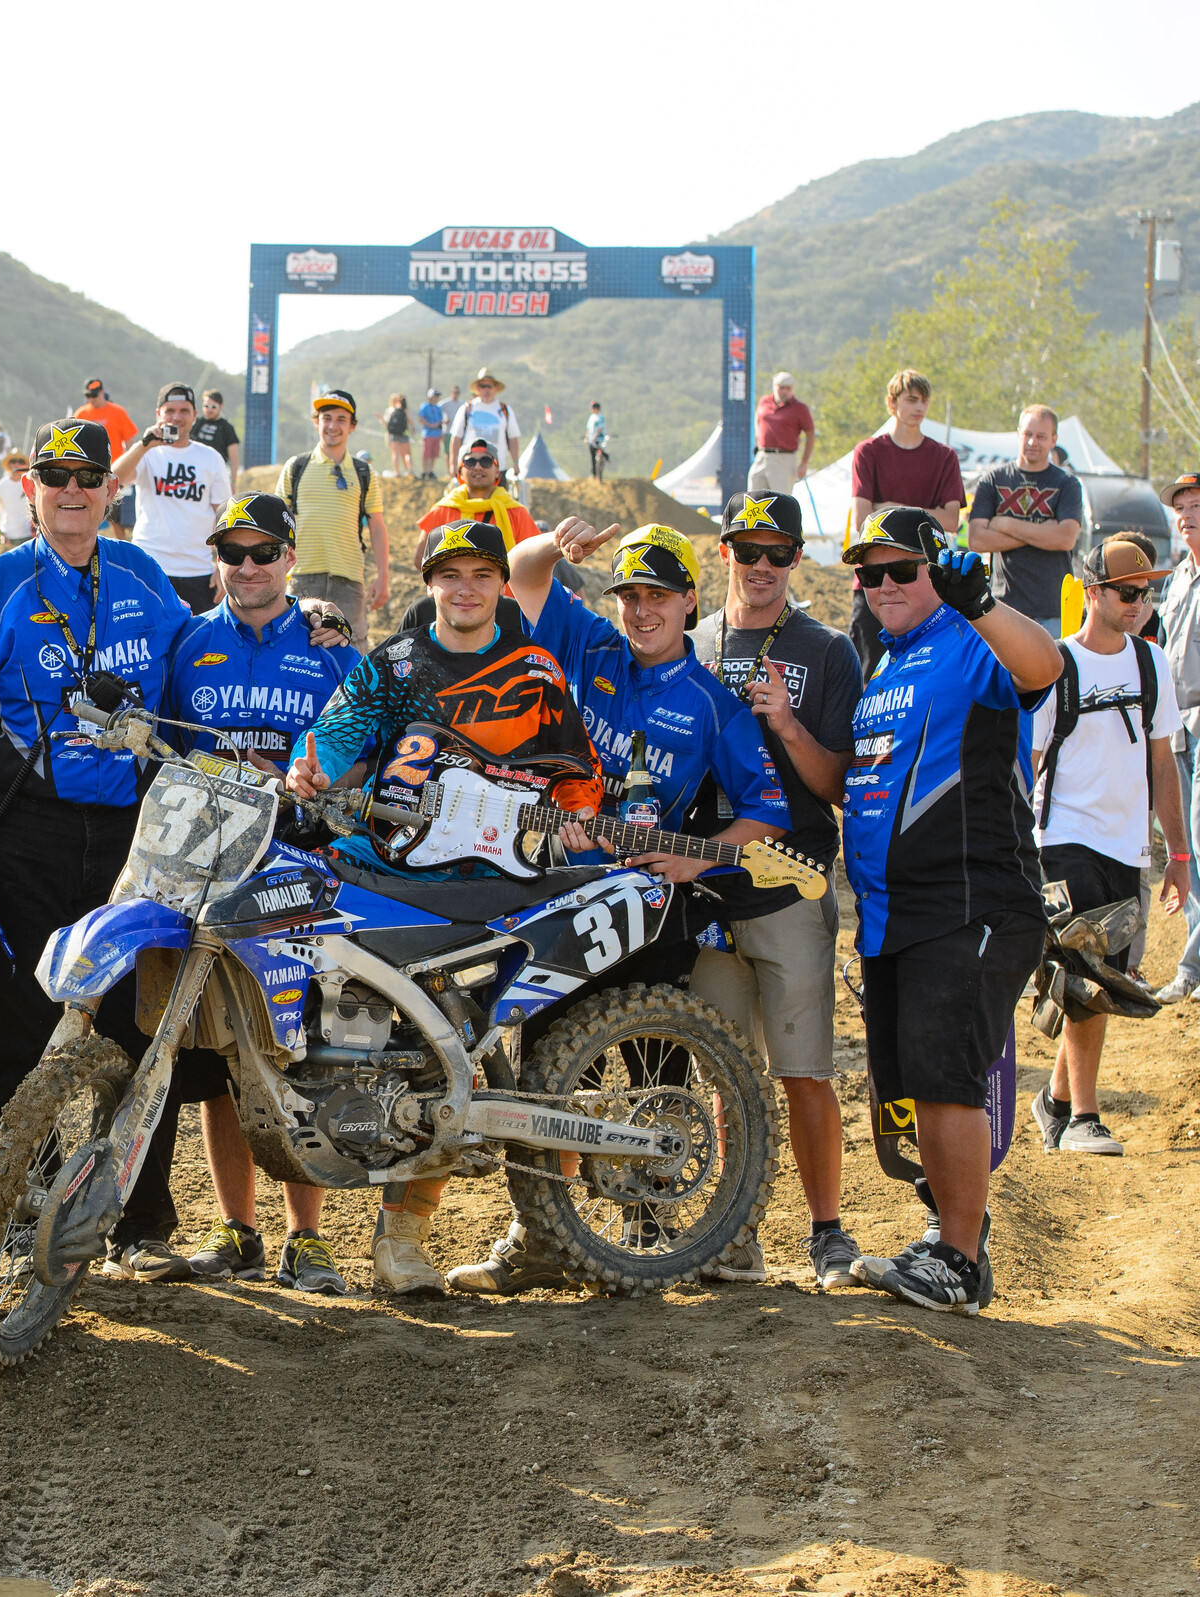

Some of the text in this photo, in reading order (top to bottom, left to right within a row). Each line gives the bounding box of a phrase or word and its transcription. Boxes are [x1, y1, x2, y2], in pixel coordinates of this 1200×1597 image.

[449, 231, 549, 249] LUCAS OIL
[409, 261, 588, 282] MOTOCROSS
[408, 281, 588, 291] CHAMPIONSHIP
[445, 291, 550, 315] FINISH
[167, 462, 196, 480] LAS
[154, 476, 206, 502] VEGAS
[48, 552, 68, 577] YAMAHA
[112, 599, 141, 609] GYTR
[281, 610, 297, 628] YAMAHA
[925, 607, 946, 629] YAMAHA
[284, 655, 322, 667] GYTR
[395, 661, 409, 676] VP
[666, 660, 688, 677] YAMAHA
[287, 667, 323, 678] DUNLOP
[220, 685, 314, 719] YAMAHA
[861, 685, 914, 719] YAMAHA
[202, 712, 306, 725] RACING
[653, 707, 695, 722] GYTR
[853, 712, 906, 731] RACING
[655, 720, 693, 736] DUNLOP
[196, 757, 223, 776] PRO
[380, 733, 438, 788] 2
[434, 752, 472, 768] 250
[485, 764, 550, 786] GLEN HELEN
[222, 783, 240, 798] OIL
[380, 790, 420, 803] MOTOCROSS
[864, 791, 889, 800] KYB
[157, 784, 262, 868] 37
[275, 842, 327, 871] YAMAHA
[473, 843, 502, 856] YAMAHA
[266, 871, 302, 886] GYTR
[757, 875, 779, 885] Squier
[252, 883, 314, 914] YAMALUBE
[573, 886, 644, 974] 37
[264, 964, 306, 986] YAMAHA
[274, 990, 302, 1003] FMF
[141, 1084, 168, 1130] YAMALUBE
[339, 1122, 378, 1132] GYTR
[531, 1114, 603, 1145] YAMALUBE
[604, 1132, 650, 1147] GYTR
[119, 1133, 145, 1188] BRAKING
